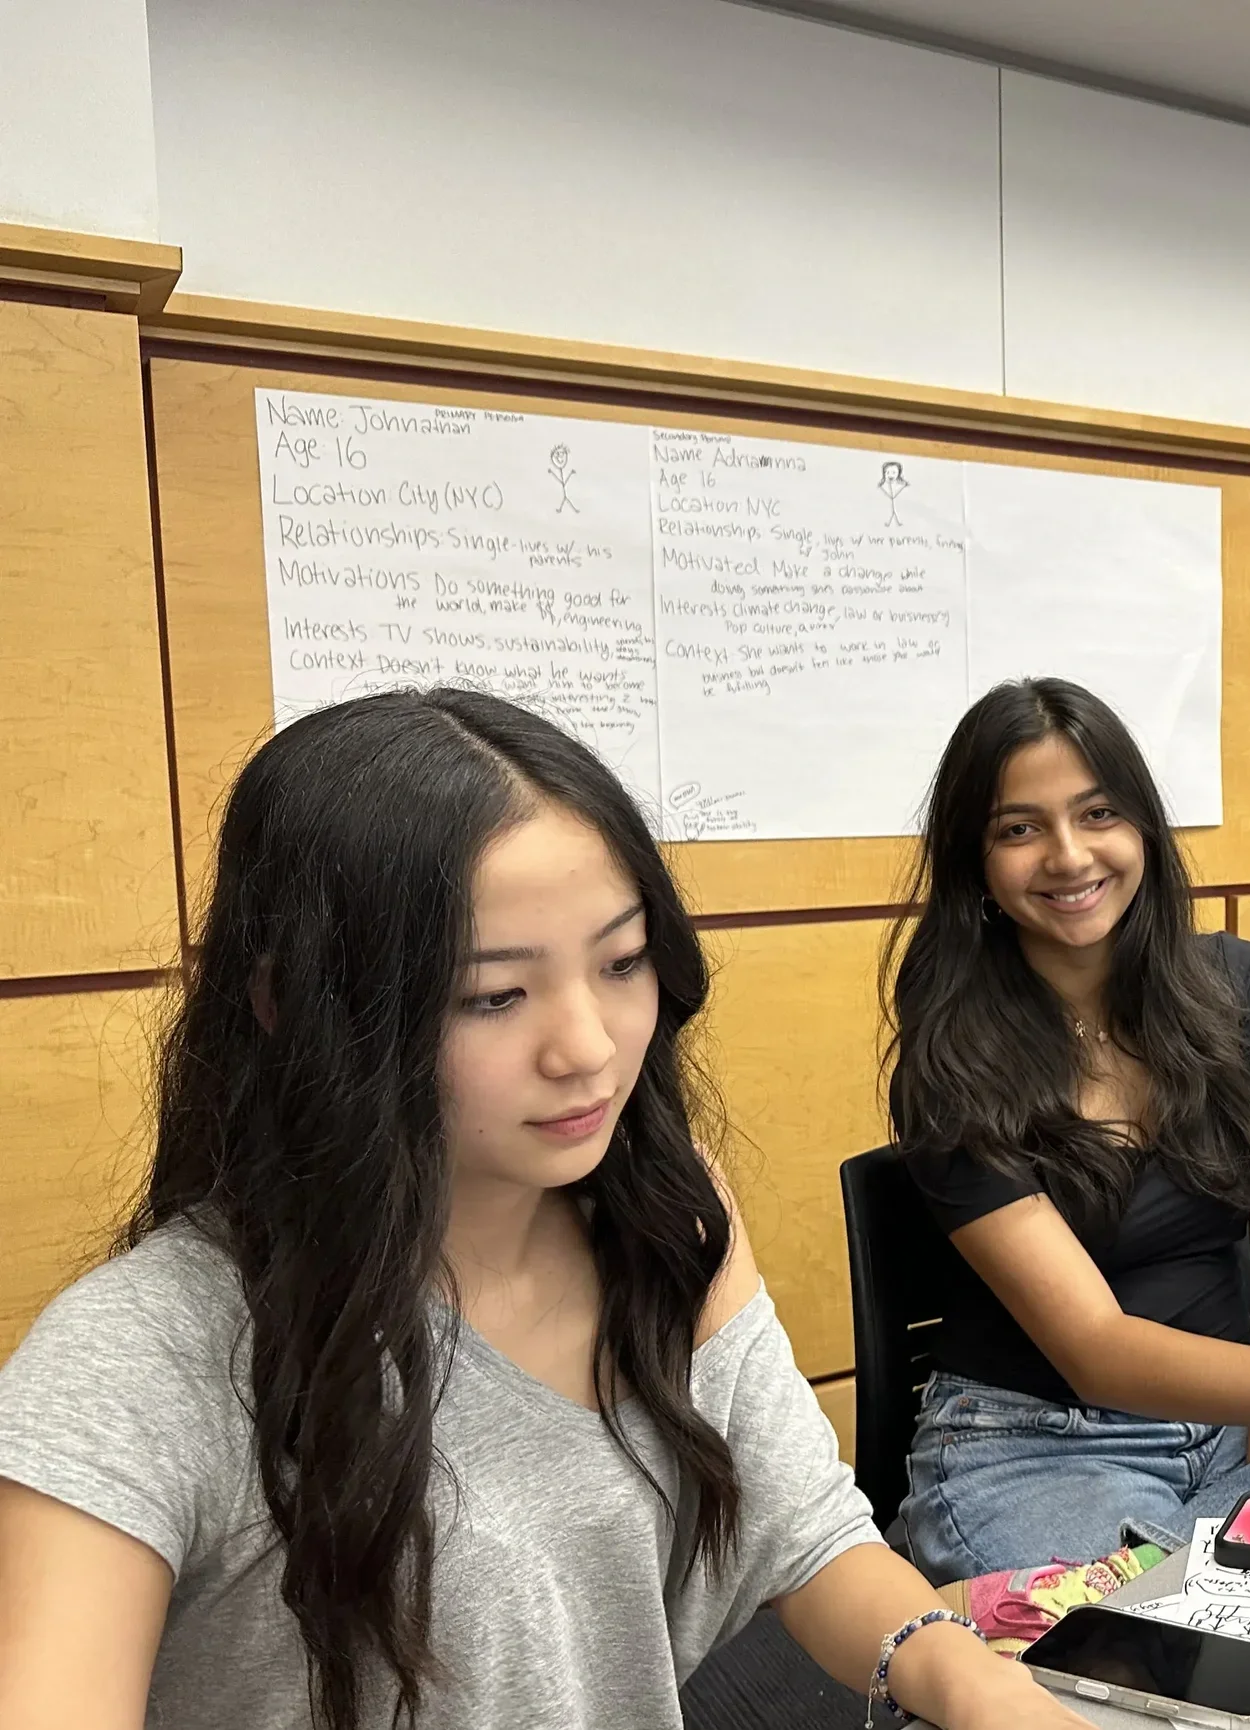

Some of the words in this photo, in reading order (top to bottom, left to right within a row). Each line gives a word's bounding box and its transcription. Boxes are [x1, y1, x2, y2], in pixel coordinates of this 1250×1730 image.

[349, 405, 471, 434] Johnathan
[336, 436, 367, 470] 16
[659, 467, 687, 494] Age
[701, 470, 716, 488] 16
[399, 480, 438, 514] City
[445, 481, 503, 511] (NYC)
[747, 496, 781, 519] NYC
[529, 553, 582, 568] parents
[587, 544, 612, 559] his
[662, 545, 761, 575] Motivated
[823, 565, 832, 577] a
[838, 564, 893, 586] change
[395, 594, 417, 610] the
[490, 600, 527, 612] make
[435, 572, 458, 596] Do
[467, 579, 555, 602] something
[564, 591, 602, 611] good
[609, 588, 632, 606] for
[710, 579, 745, 600] doing
[660, 594, 727, 617] Interests
[284, 616, 367, 643] Interests
[379, 623, 411, 644] TV
[289, 649, 365, 670] Context
[455, 660, 497, 677] know
[504, 661, 541, 678] what
[550, 661, 569, 679] he
[579, 668, 627, 682] wants
[665, 638, 728, 667] Context
[738, 644, 762, 660] She
[768, 640, 804, 656] wants
[814, 641, 827, 653] to
[549, 679, 574, 689] him
